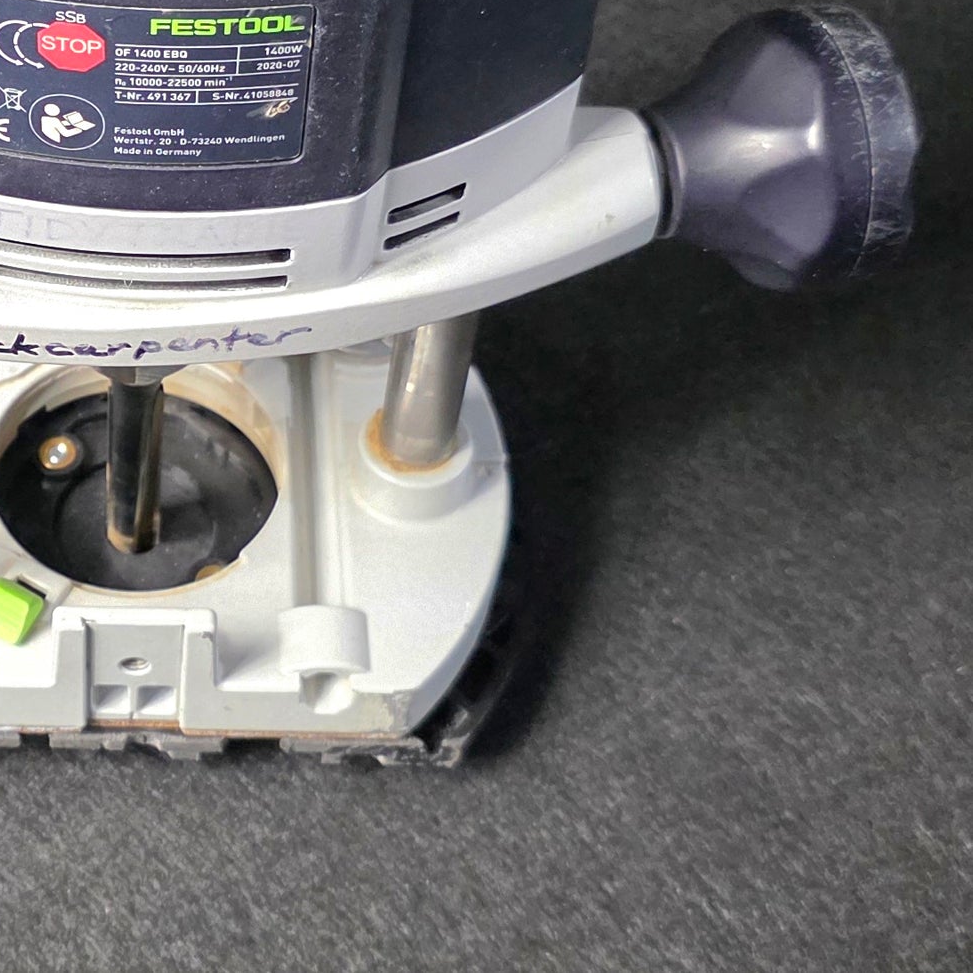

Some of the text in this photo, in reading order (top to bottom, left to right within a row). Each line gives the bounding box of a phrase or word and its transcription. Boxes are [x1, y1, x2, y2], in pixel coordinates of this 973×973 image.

[55, 10, 87, 24] SSB
[149, 15, 305, 36] FESTOOL
[41, 35, 103, 55] STOP
[264, 44, 304, 56] 1400W
[114, 48, 188, 59] OF 1400 EBQ
[178, 63, 226, 74] 50/60Hz
[256, 59, 300, 70] 2020-07
[129, 77, 202, 87] 10000-22500
[114, 91, 191, 102] T-Nr. 491 367
[113, 126, 185, 136] Festool GmbH
[113, 134, 286, 146] Wertstr. 20 D-73240 Wendlingen
[113, 146, 203, 157] Made in Germany
